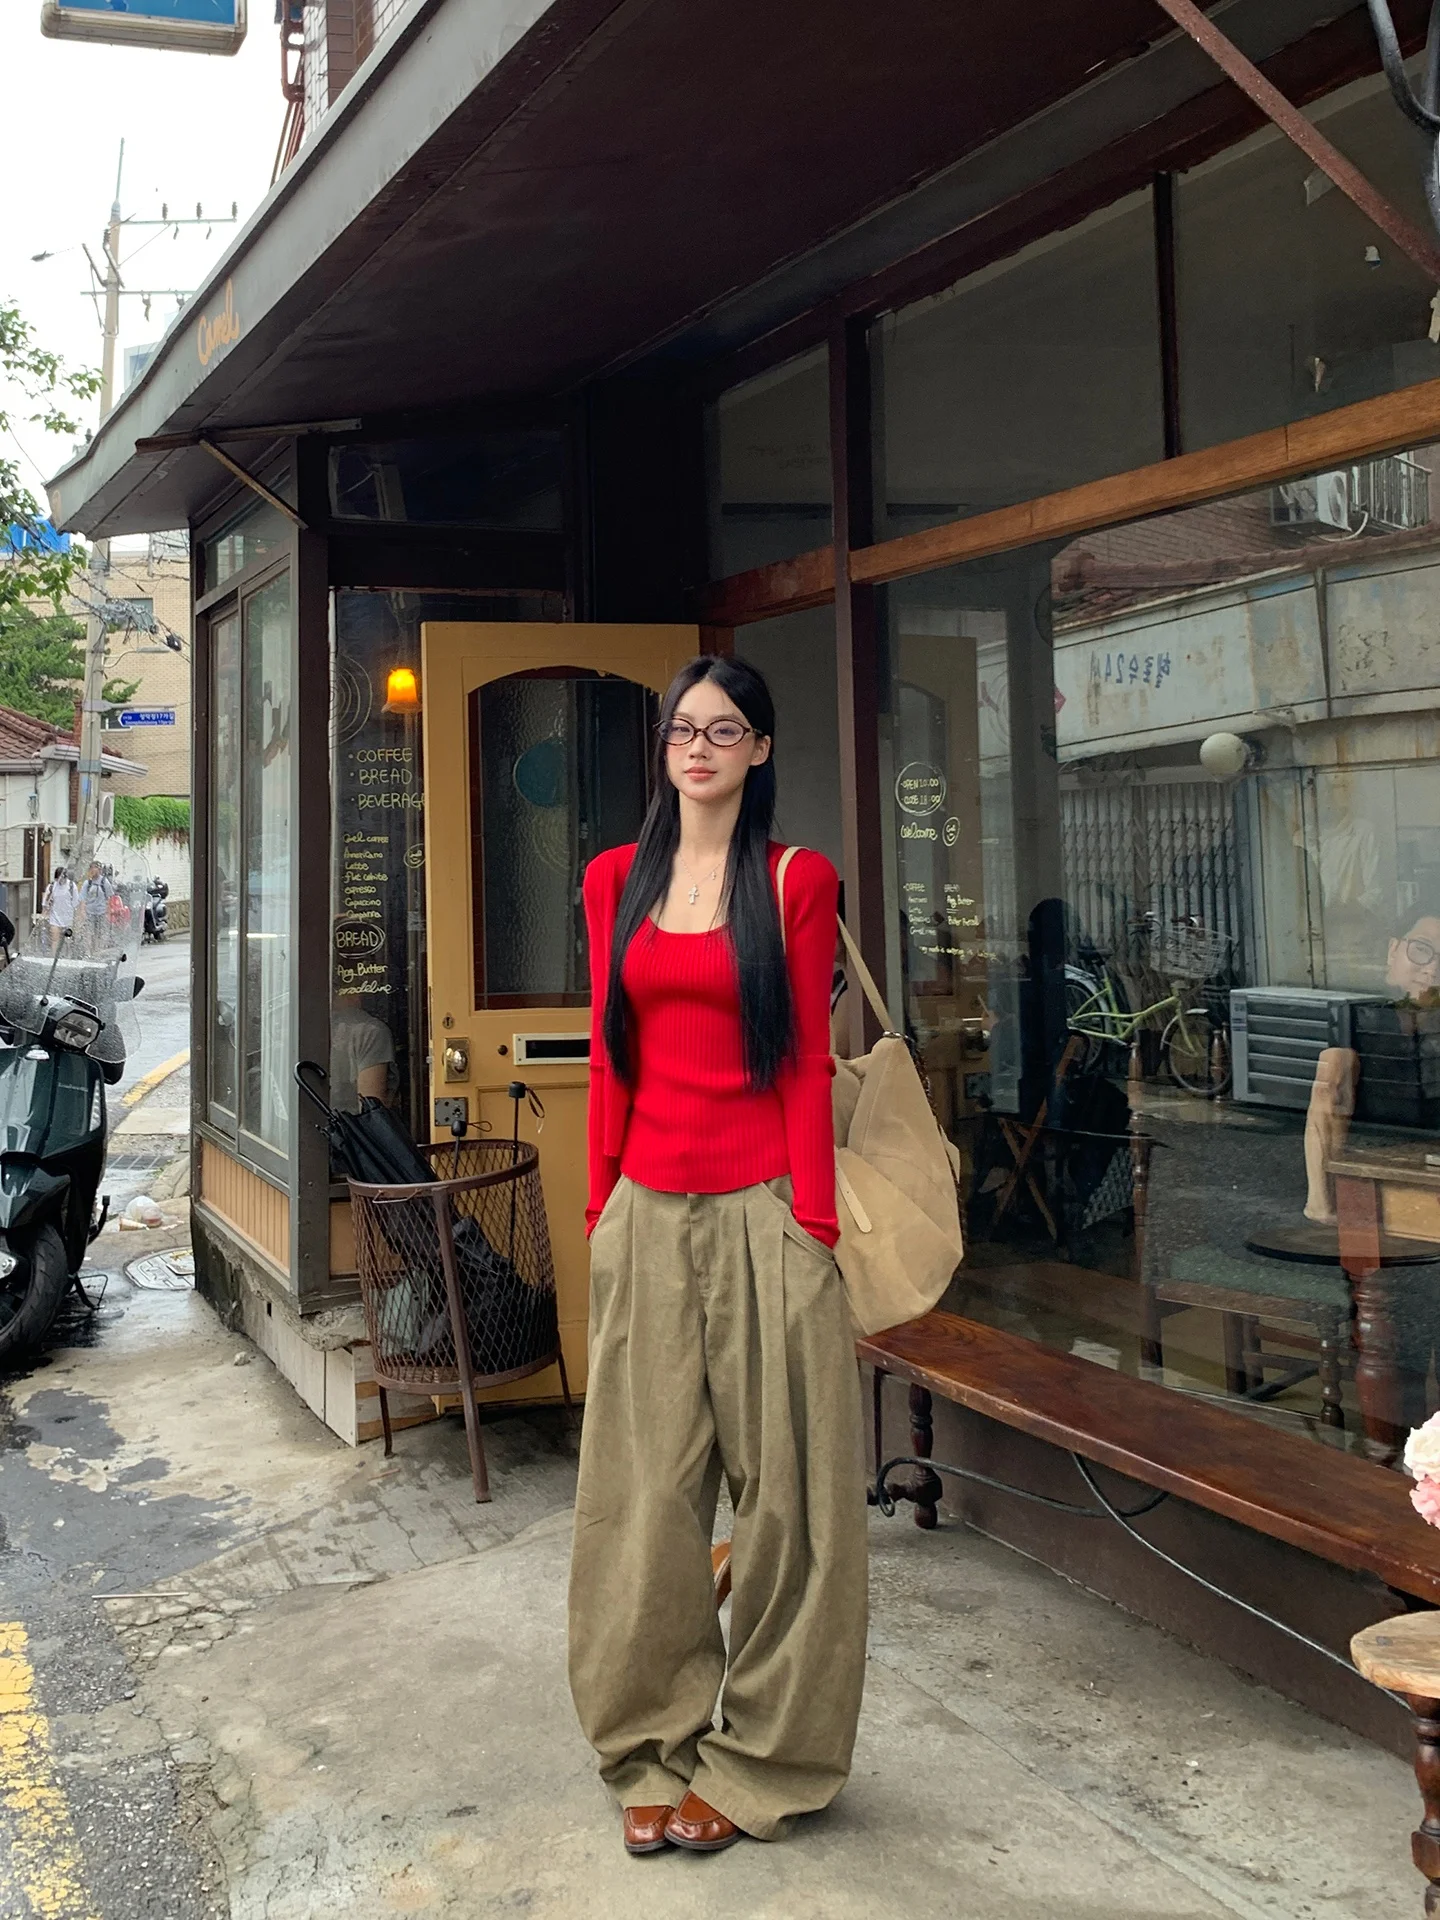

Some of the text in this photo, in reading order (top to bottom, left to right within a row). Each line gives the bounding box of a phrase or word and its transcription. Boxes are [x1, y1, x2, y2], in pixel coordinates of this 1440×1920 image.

[198, 278, 240, 366] Camel
[356, 747, 413, 763] COFFEE
[358, 768, 413, 786] BREAD
[336, 930, 379, 948] BREAD
[357, 962, 389, 977] Butter
